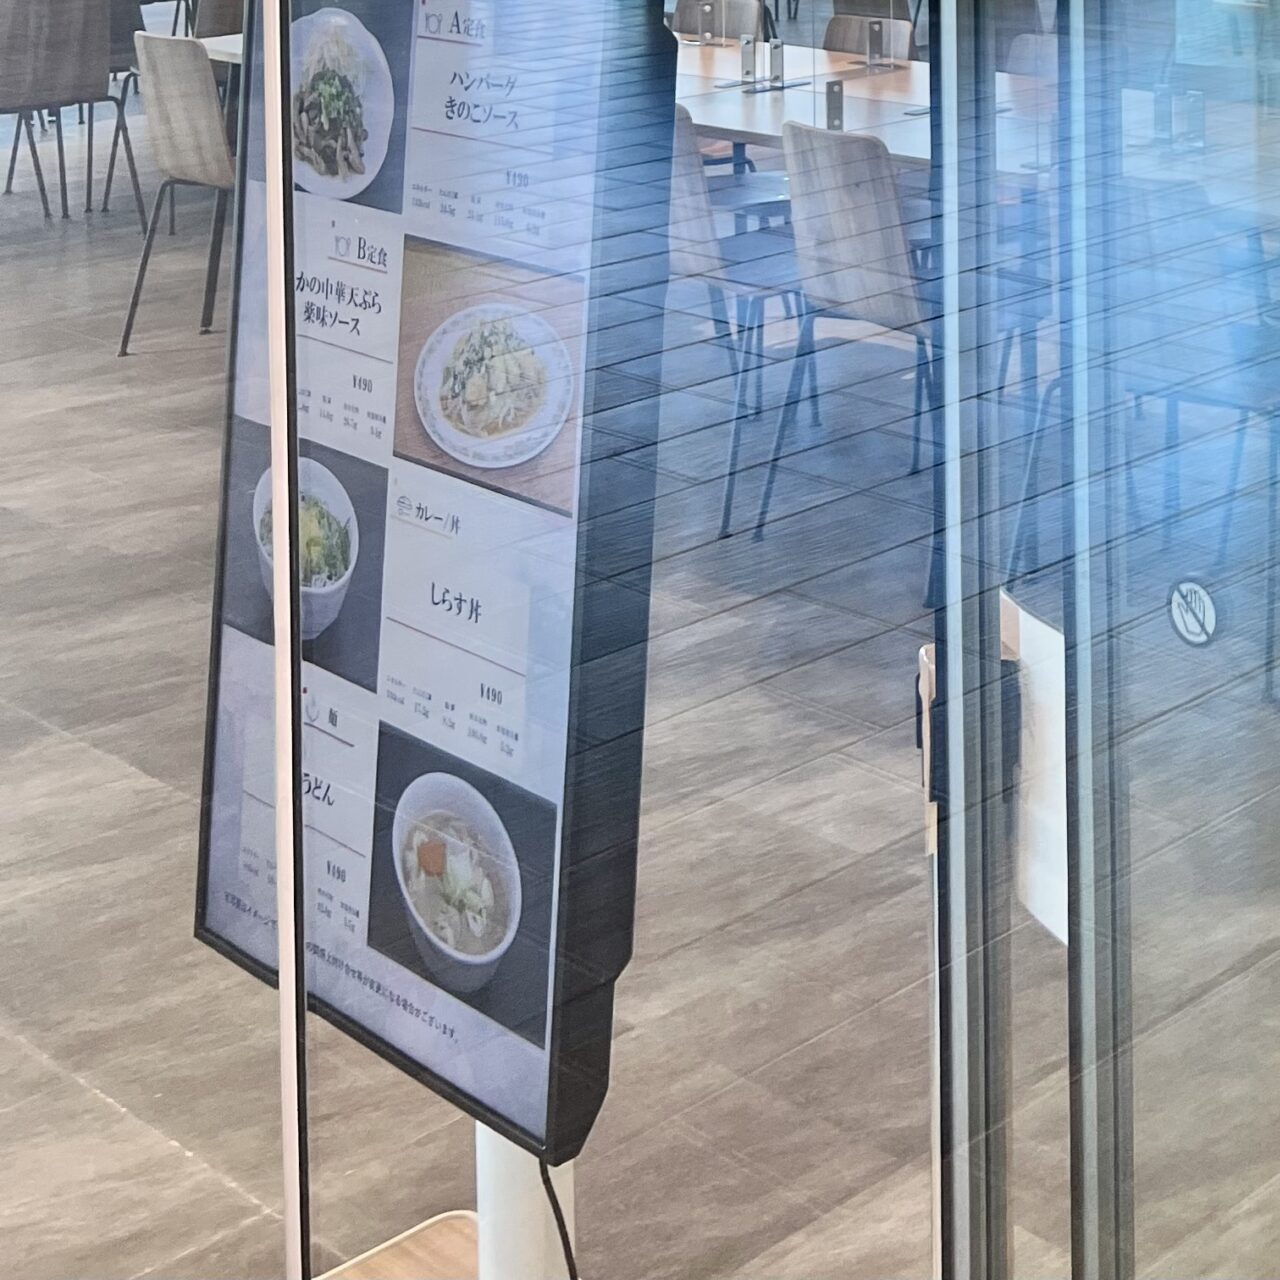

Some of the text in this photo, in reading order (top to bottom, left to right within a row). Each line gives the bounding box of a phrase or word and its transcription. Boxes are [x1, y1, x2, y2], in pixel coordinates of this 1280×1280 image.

[444, 96, 519, 129] きのこソース
[357, 236, 388, 268] B定食
[303, 300, 361, 336] 薬味ソース
[430, 581, 482, 624] しらす丼
[303, 772, 334, 806] うどん
